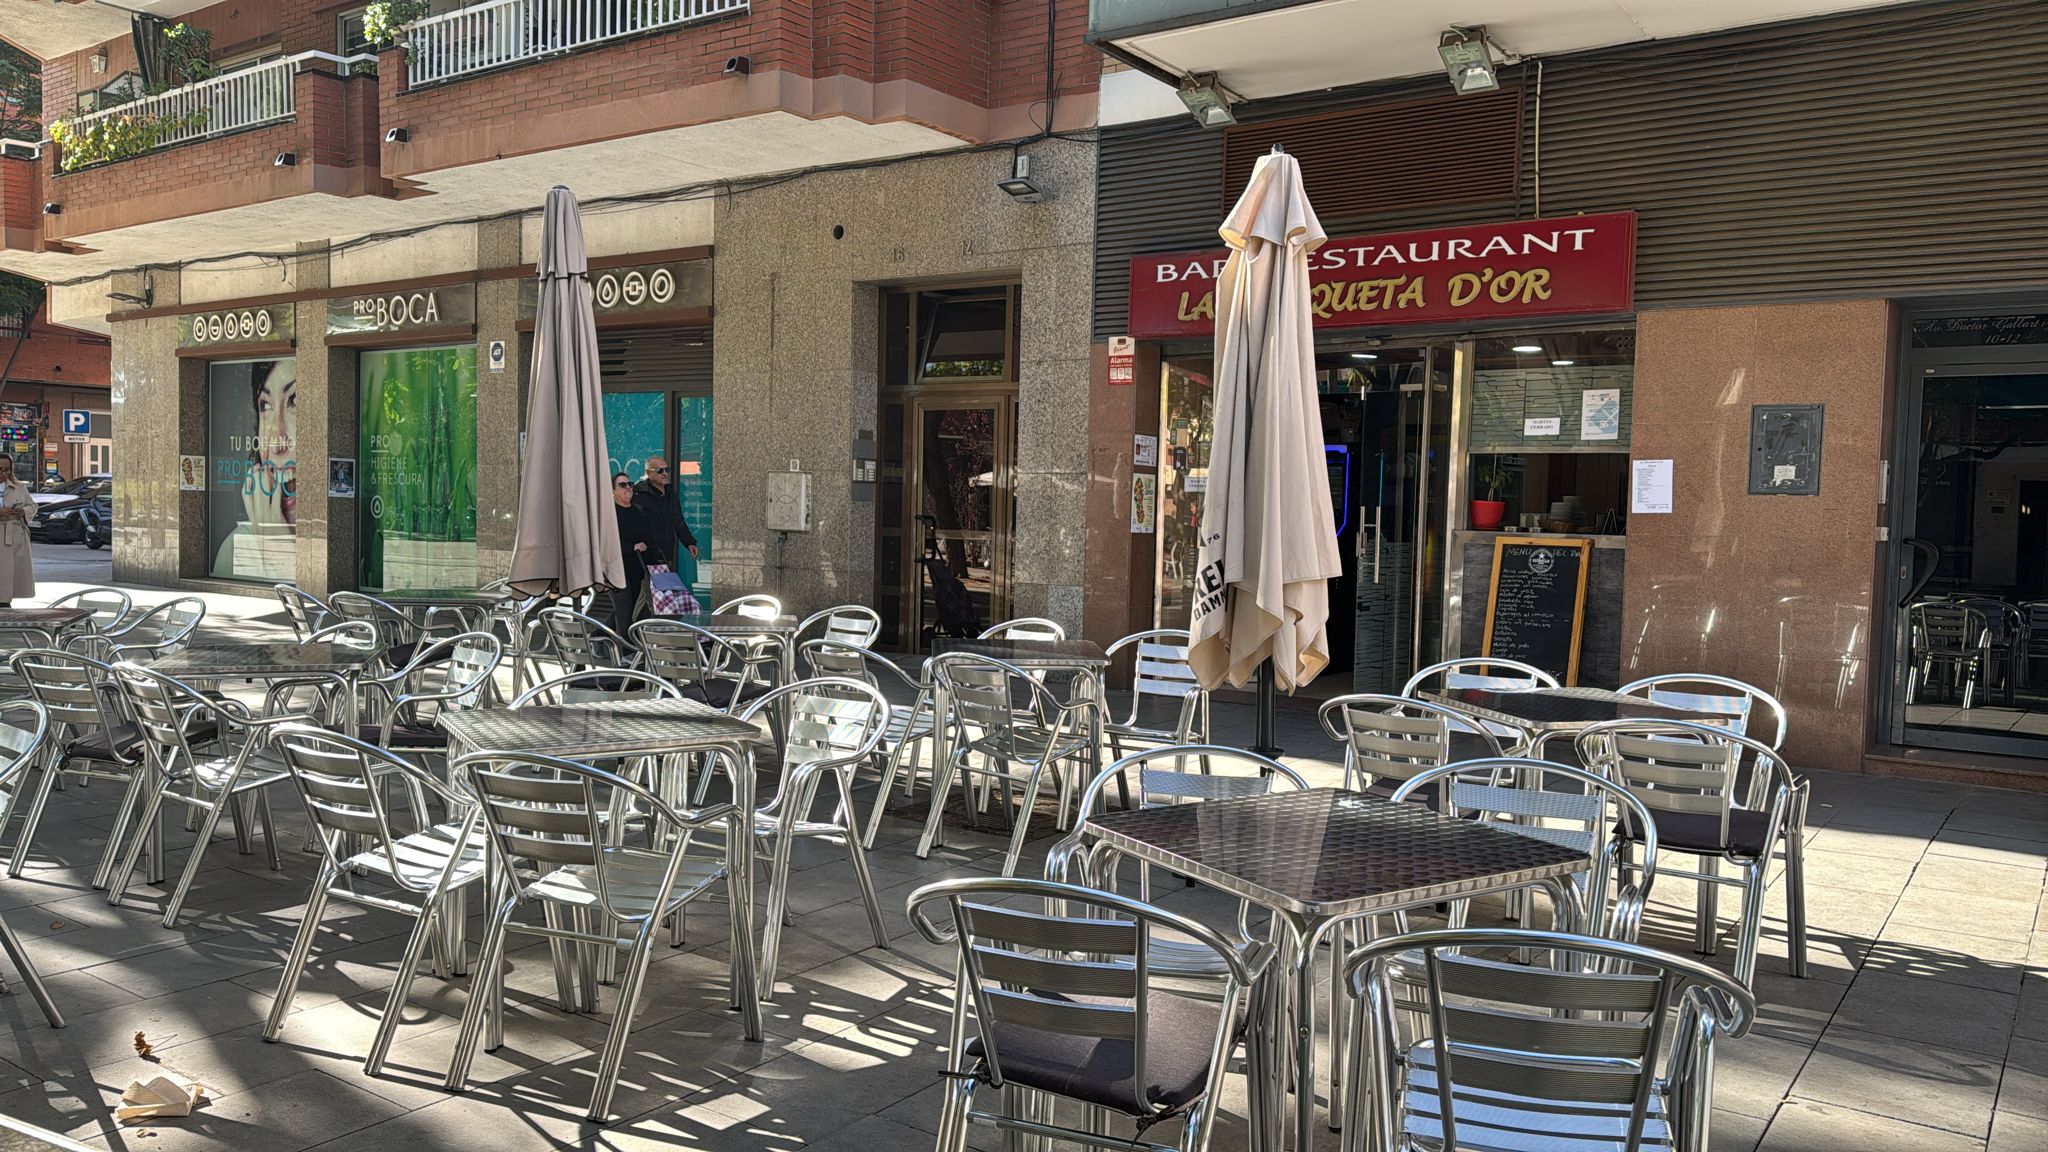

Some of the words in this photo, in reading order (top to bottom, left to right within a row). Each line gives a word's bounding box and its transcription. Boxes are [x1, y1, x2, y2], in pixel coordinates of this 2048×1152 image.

[889, 248, 905, 262] 16
[960, 241, 974, 256] 14
[1306, 228, 1596, 271] ESTAURANT
[354, 299, 375, 315] PRO
[376, 292, 439, 326] BOCA
[1985, 334, 2020, 344] 10-12
[69, 413, 86, 431] P
[229, 436, 242, 451] TU
[370, 435, 390, 448] PRO
[217, 460, 241, 477] PRO
[371, 457, 407, 469] HIGIENE
